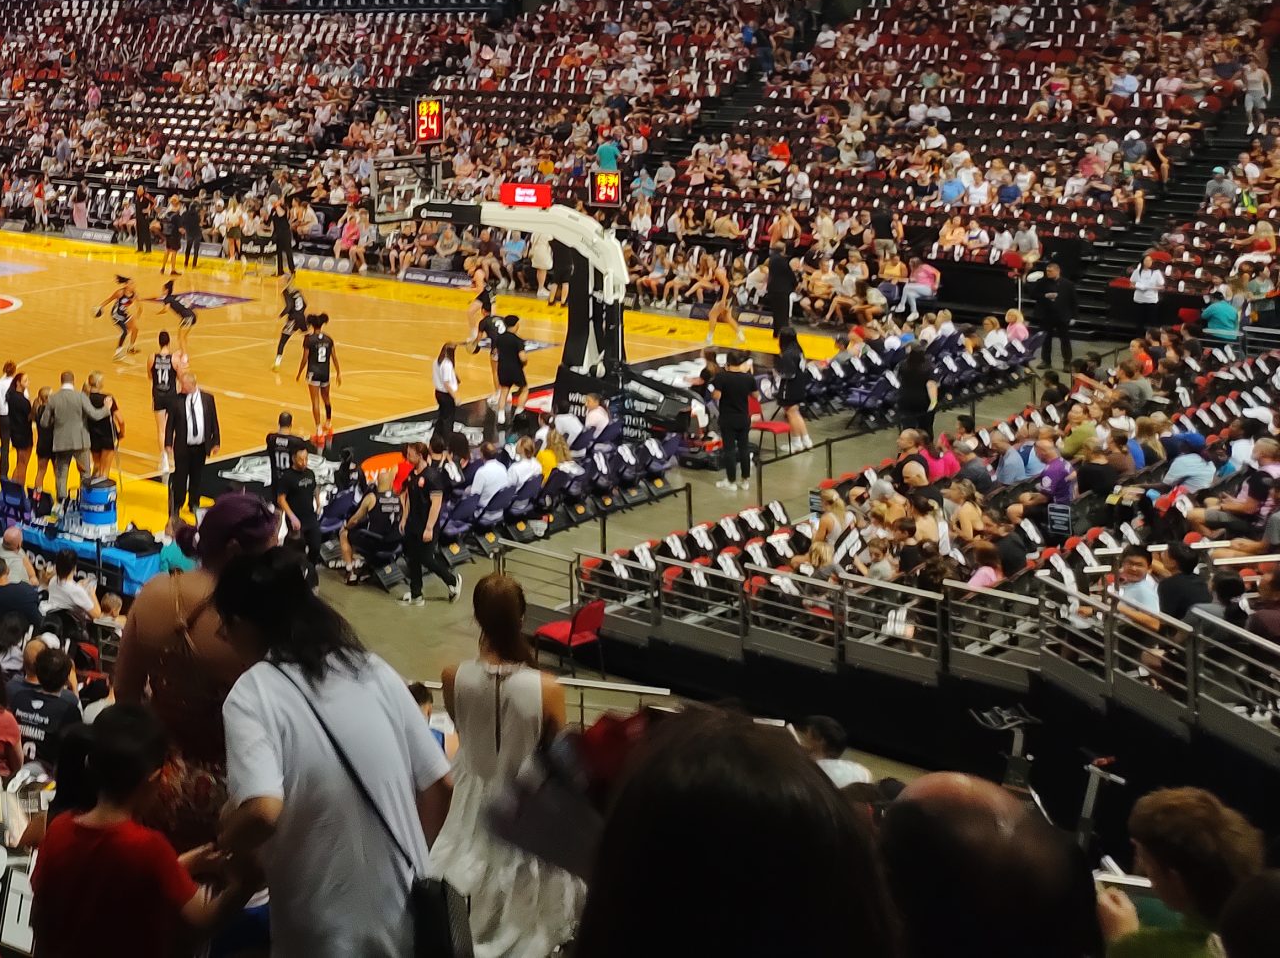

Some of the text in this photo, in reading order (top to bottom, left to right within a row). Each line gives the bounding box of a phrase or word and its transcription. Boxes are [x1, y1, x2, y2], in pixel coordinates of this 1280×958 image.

[419, 115, 438, 138] 24
[599, 186, 615, 201] 24
[318, 347, 326, 362] 2
[156, 369, 169, 384] 14
[275, 451, 290, 469] 10
